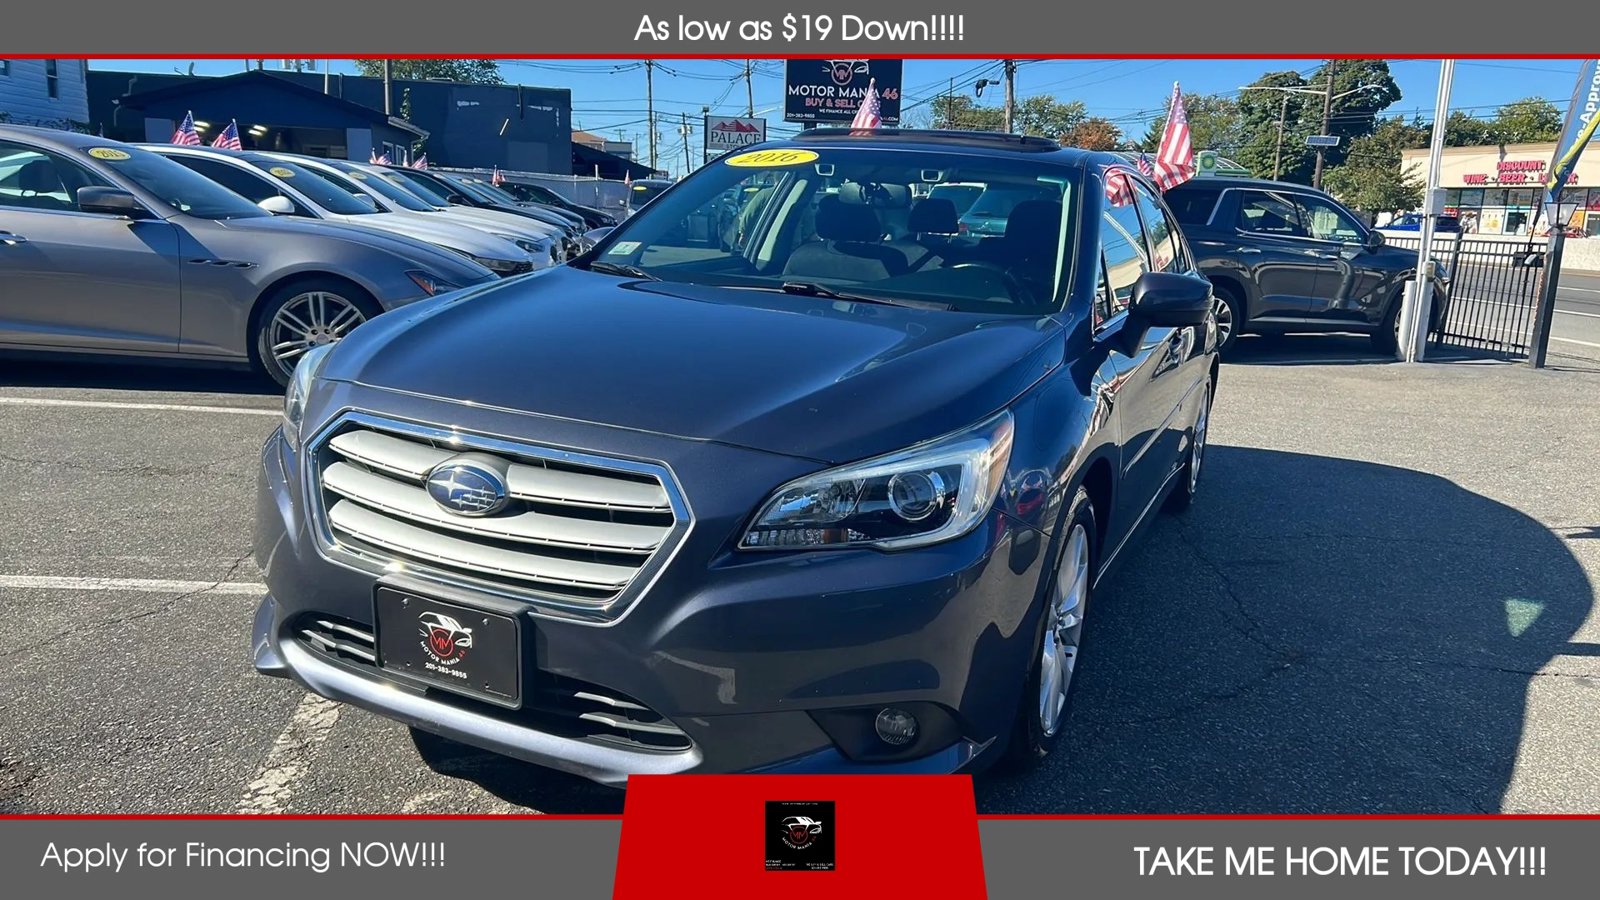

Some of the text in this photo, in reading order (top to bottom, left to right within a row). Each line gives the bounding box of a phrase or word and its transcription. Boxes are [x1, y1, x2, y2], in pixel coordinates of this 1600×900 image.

[788, 85, 899, 100] MOTOR MANA 46
[805, 97, 823, 107] BUY
[826, 98, 833, 107] &
[834, 98, 856, 109] SELL
[711, 131, 761, 145] PALACE
[737, 152, 801, 164] 2016
[1497, 160, 1543, 172] DISCOUNT
[1463, 174, 1487, 184] WINE
[1500, 173, 1526, 184] BEER
[420, 641, 440, 663] MOTOR
[440, 657, 460, 665] MANIA
